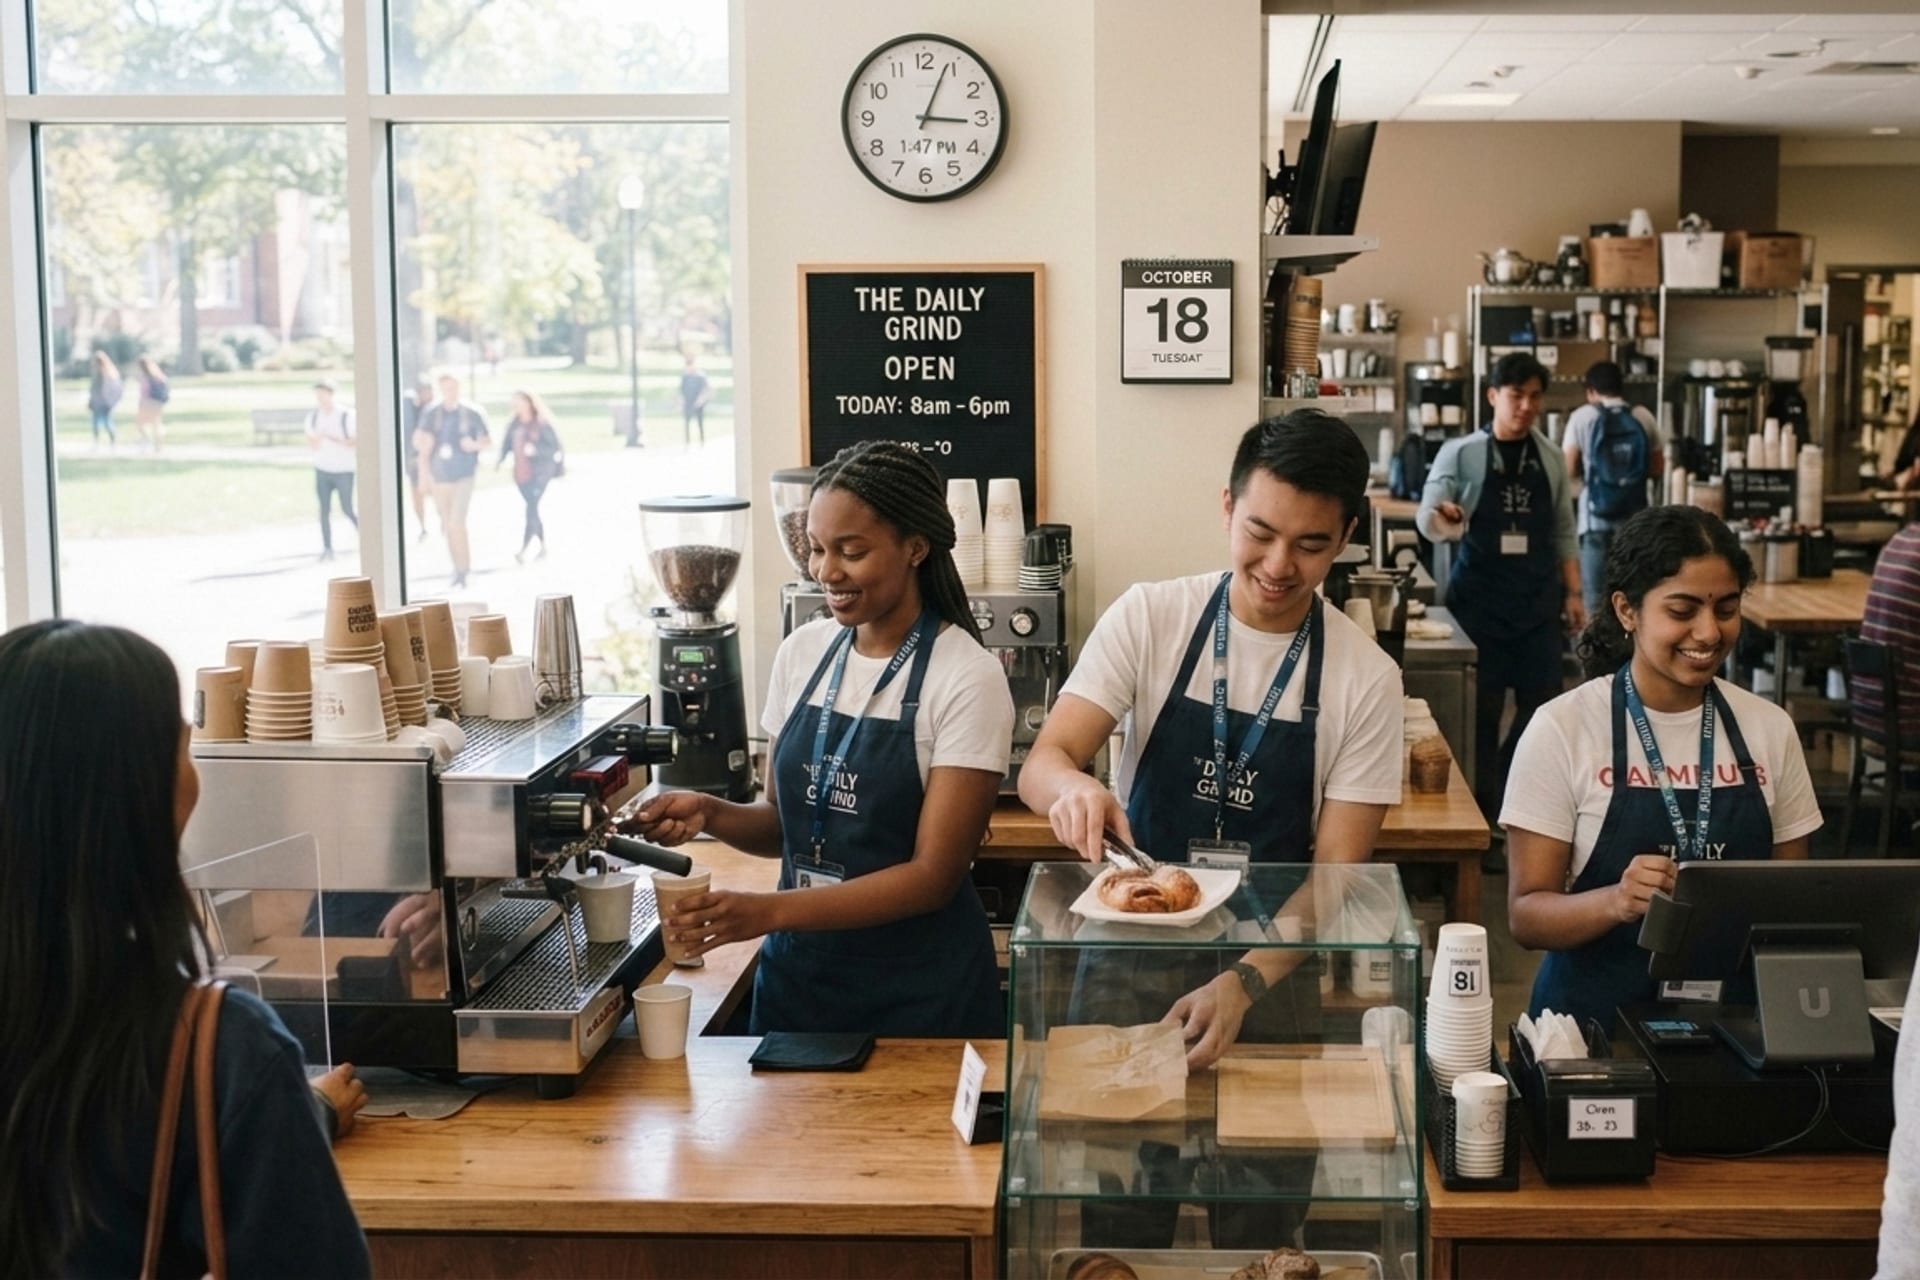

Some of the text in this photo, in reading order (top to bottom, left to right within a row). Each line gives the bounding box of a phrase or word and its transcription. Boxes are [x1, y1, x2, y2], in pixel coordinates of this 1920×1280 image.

[915, 52, 934, 70] 12
[951, 62, 957, 77] 1
[891, 62, 904, 78] 11
[870, 82, 888, 100] 10
[966, 81, 980, 99] 2
[861, 110, 875, 127] 9
[974, 110, 989, 127] 3
[870, 139, 884, 157] 8
[966, 139, 979, 154] 4
[891, 160, 904, 177] 7
[918, 167, 933, 184] 6
[947, 160, 961, 176] 5
[1141, 271, 1213, 284] OCTOBER
[854, 287, 985, 312] THE DAILY
[885, 316, 962, 341] GRIND
[1146, 297, 1209, 344] 18
[884, 356, 955, 380] OPEN
[836, 396, 903, 415] TODAY:
[910, 396, 950, 415] 8am
[969, 396, 1010, 419] 6pm
